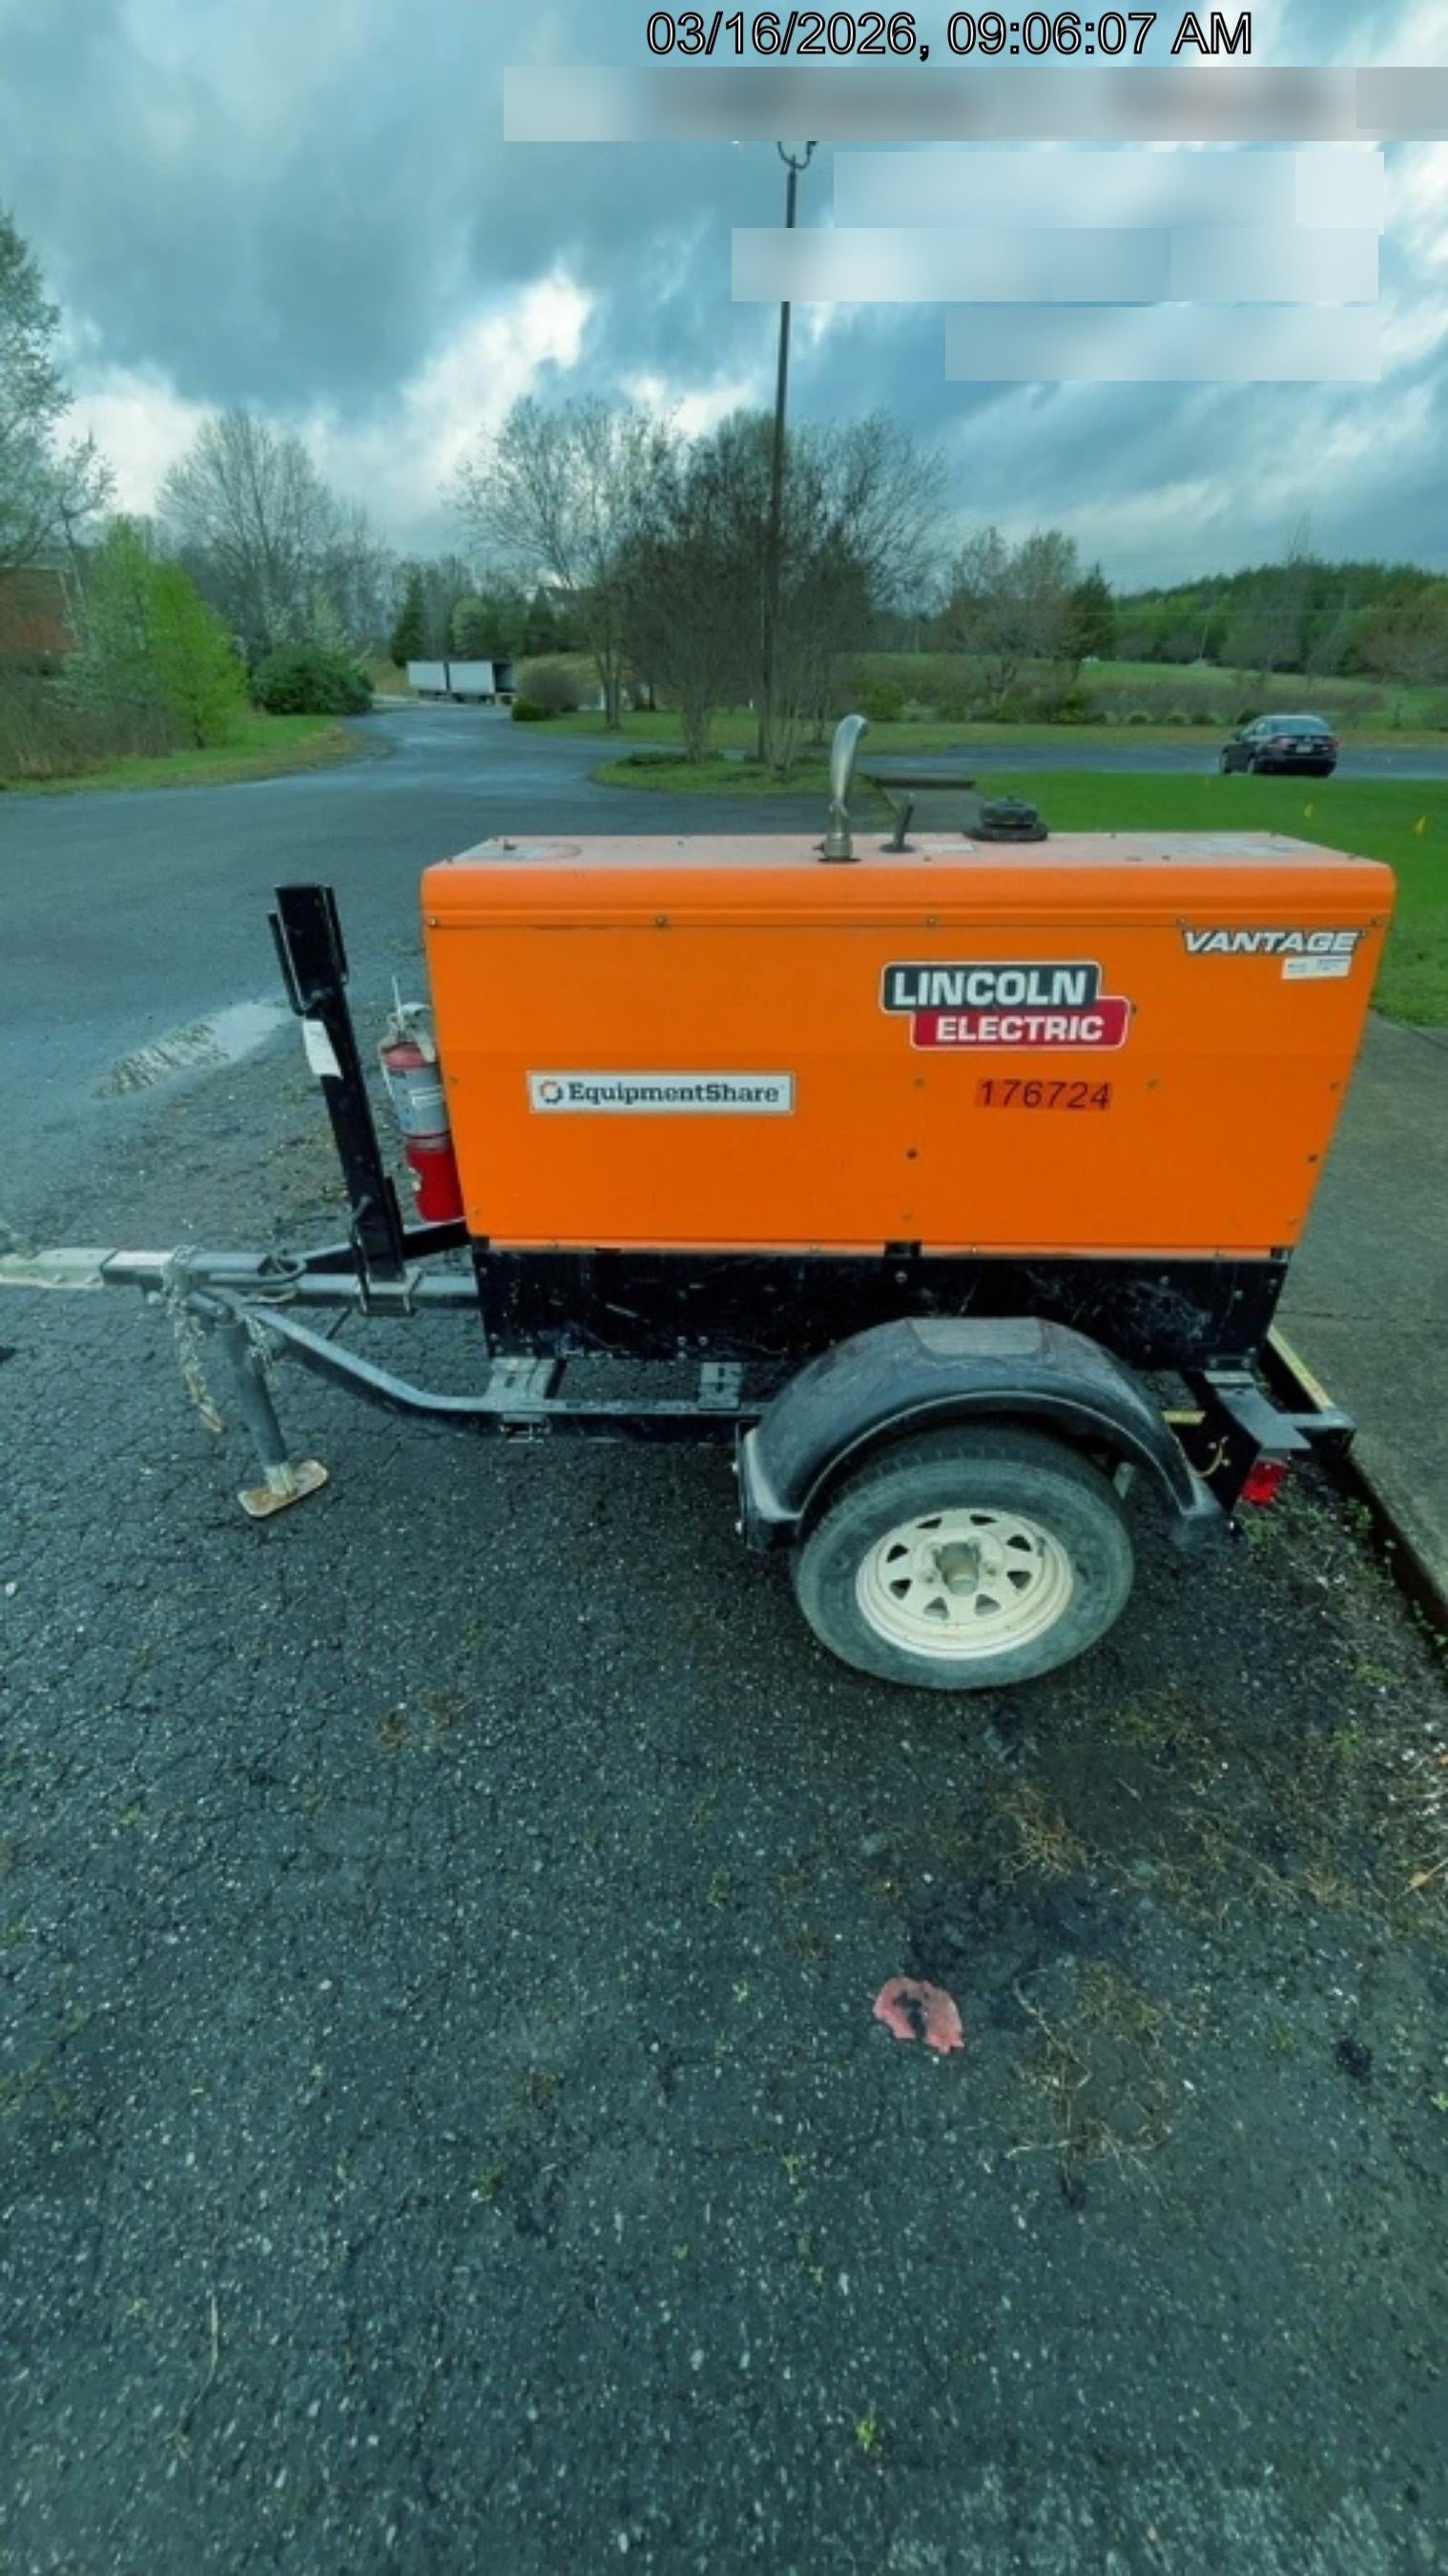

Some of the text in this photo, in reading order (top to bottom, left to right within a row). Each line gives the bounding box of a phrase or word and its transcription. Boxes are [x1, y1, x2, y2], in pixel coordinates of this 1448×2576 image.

[1184, 930, 1360, 952] VANTAGE
[893, 969, 1086, 1007] LINCOLN
[935, 1014, 1105, 1042] ELECTRIC
[568, 1081, 780, 1105] EquipmentShare
[980, 1078, 1111, 1110] 176724
